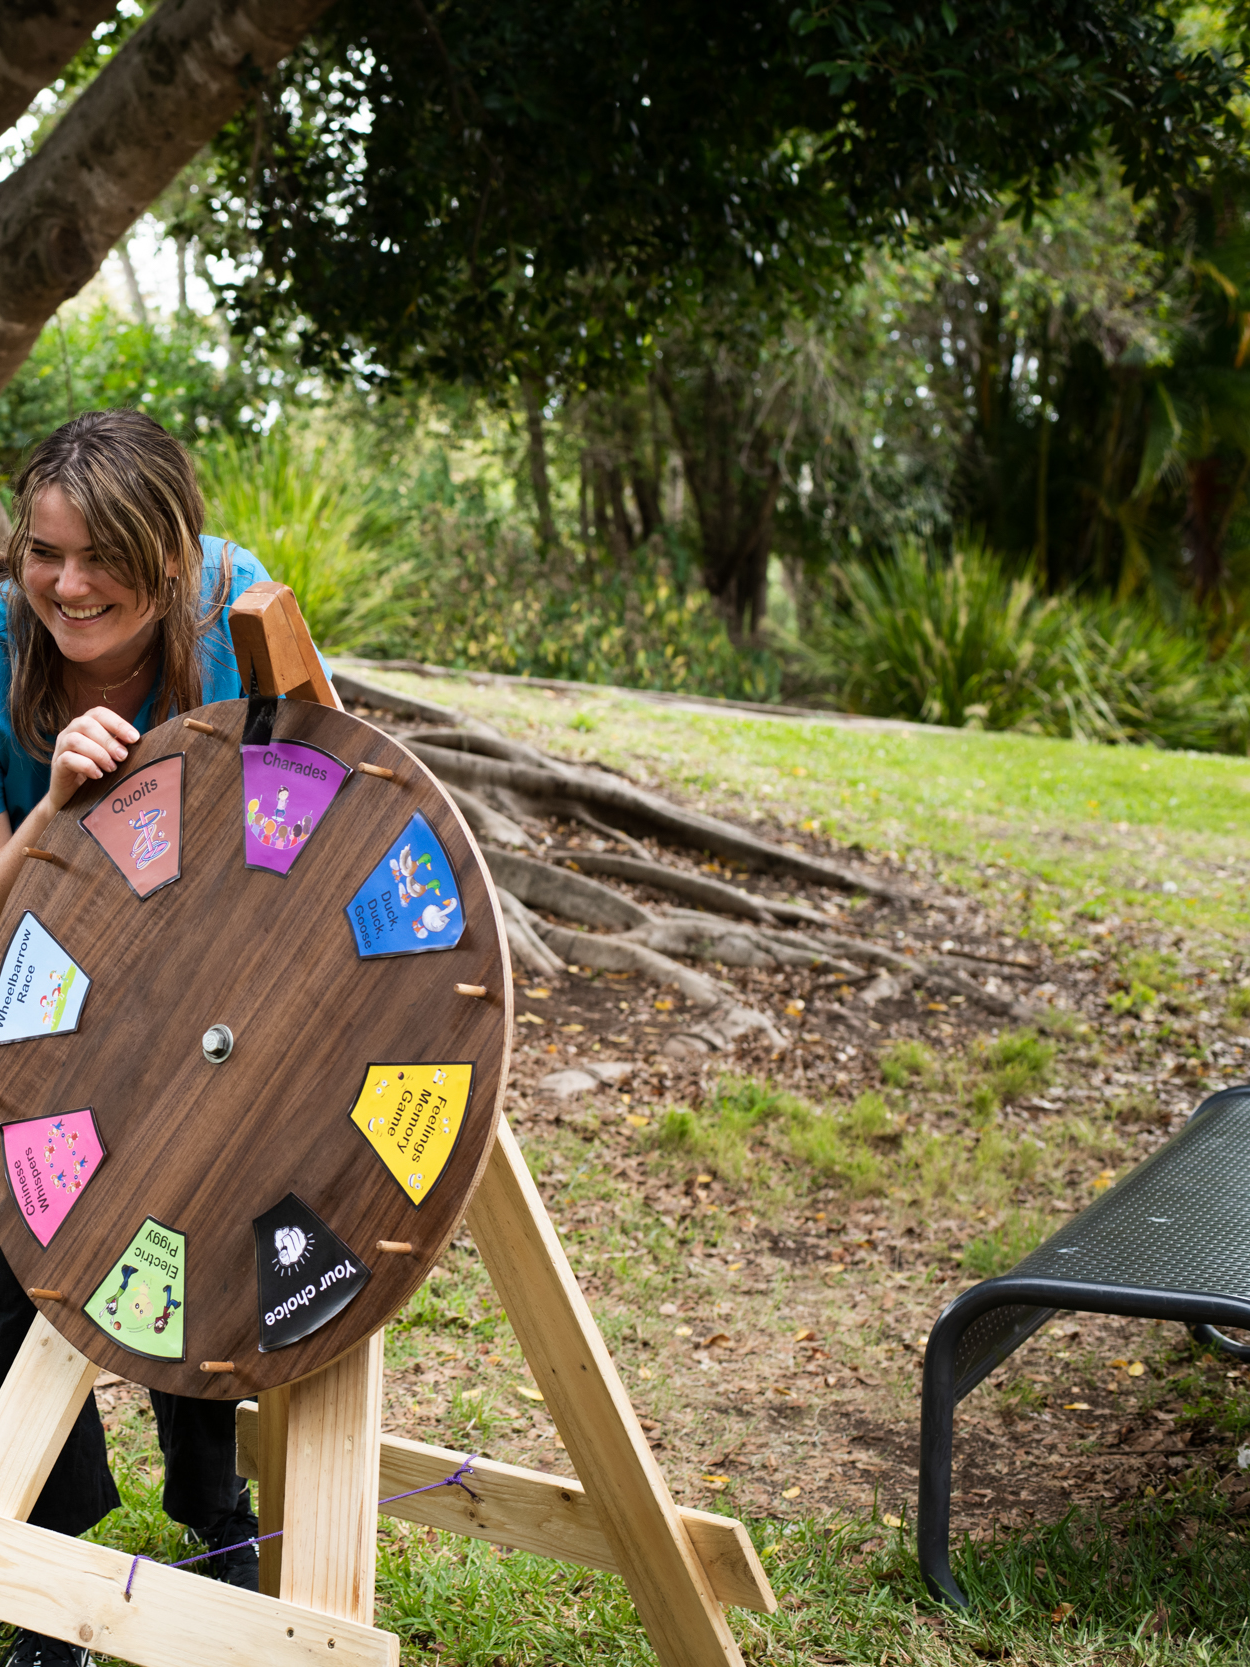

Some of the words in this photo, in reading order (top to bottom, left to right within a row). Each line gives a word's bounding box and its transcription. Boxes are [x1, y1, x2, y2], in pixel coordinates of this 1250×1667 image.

[262, 750, 328, 781] Charades
[111, 778, 158, 814] Quoits
[354, 904, 372, 950] Goose
[367, 898, 385, 940] Duck,
[380, 890, 399, 932] Duck,
[16, 965, 36, 1004] Race
[387, 1090, 413, 1137] Game
[396, 1088, 432, 1154] Memory
[411, 1095, 447, 1163] Feelings
[14, 1159, 36, 1216] Chinese
[25, 1146, 50, 1214] Whispers
[134, 1247, 179, 1280] Electric
[145, 1229, 179, 1258] Piggy
[319, 1259, 357, 1291] Your
[264, 1284, 316, 1326] choice
